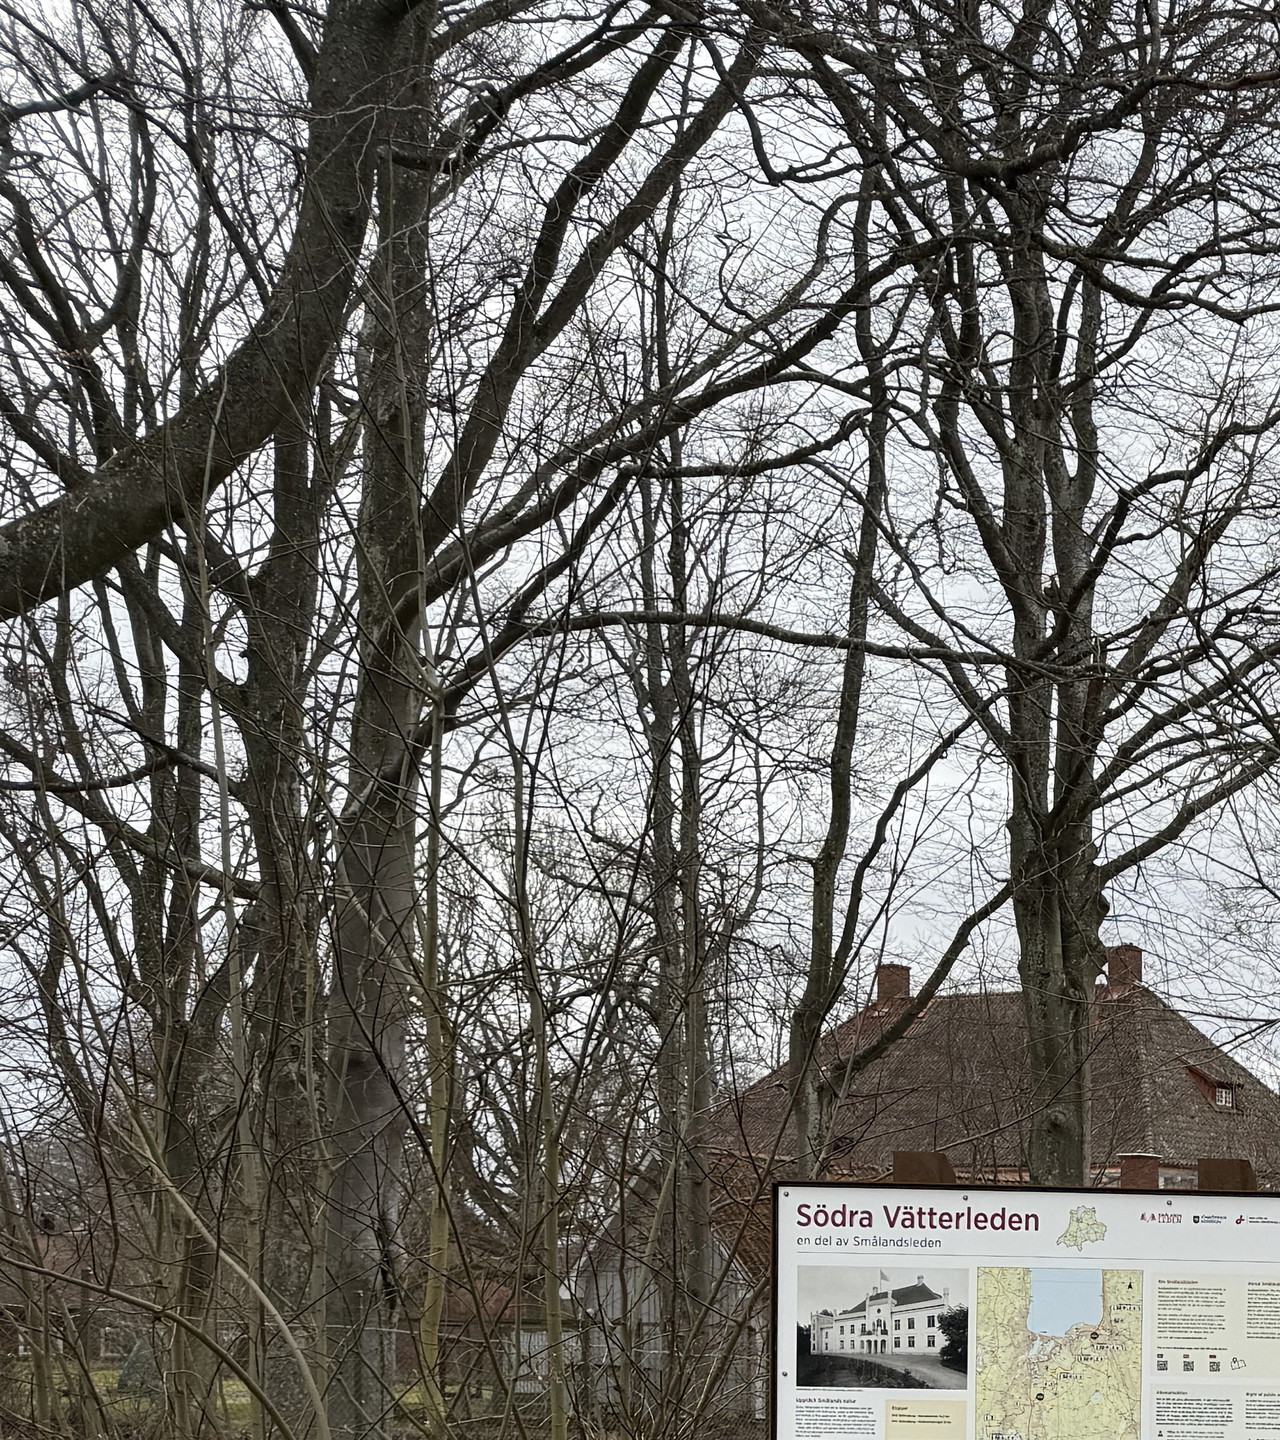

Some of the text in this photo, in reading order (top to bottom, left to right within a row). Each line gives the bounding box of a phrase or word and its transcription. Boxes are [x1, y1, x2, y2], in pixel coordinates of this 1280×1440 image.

[797, 1204, 1039, 1231] Södra Vätterleden
[815, 1236, 831, 1245] del
[836, 1238, 848, 1246] av
[854, 1236, 941, 1248] Smålandsleden
